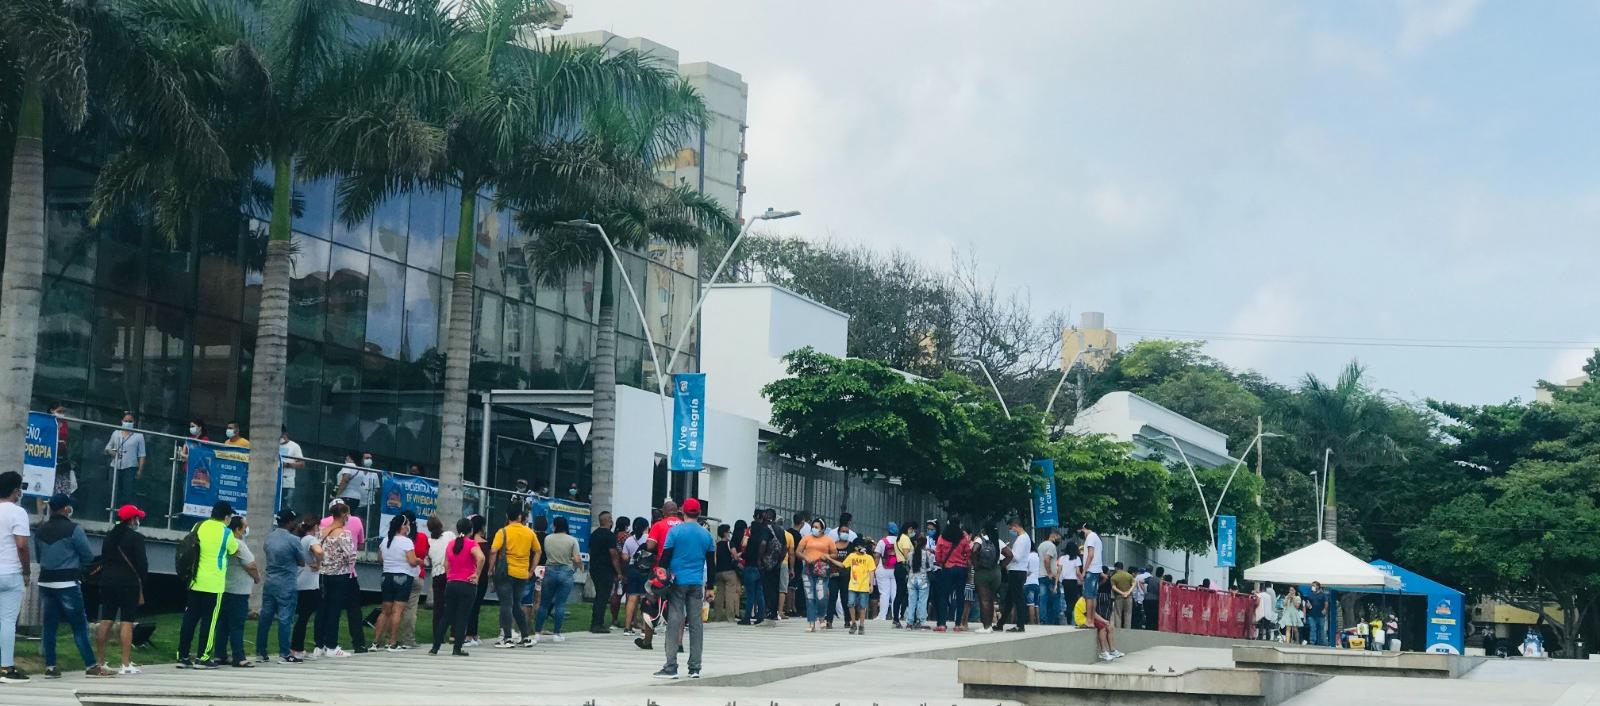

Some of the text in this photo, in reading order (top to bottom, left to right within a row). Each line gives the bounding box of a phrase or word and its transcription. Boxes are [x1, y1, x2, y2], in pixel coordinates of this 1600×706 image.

[688, 398, 699, 438] alegría
[678, 425, 688, 451] Vive
[687, 440, 697, 451] la
[25, 443, 52, 459] PROPIA
